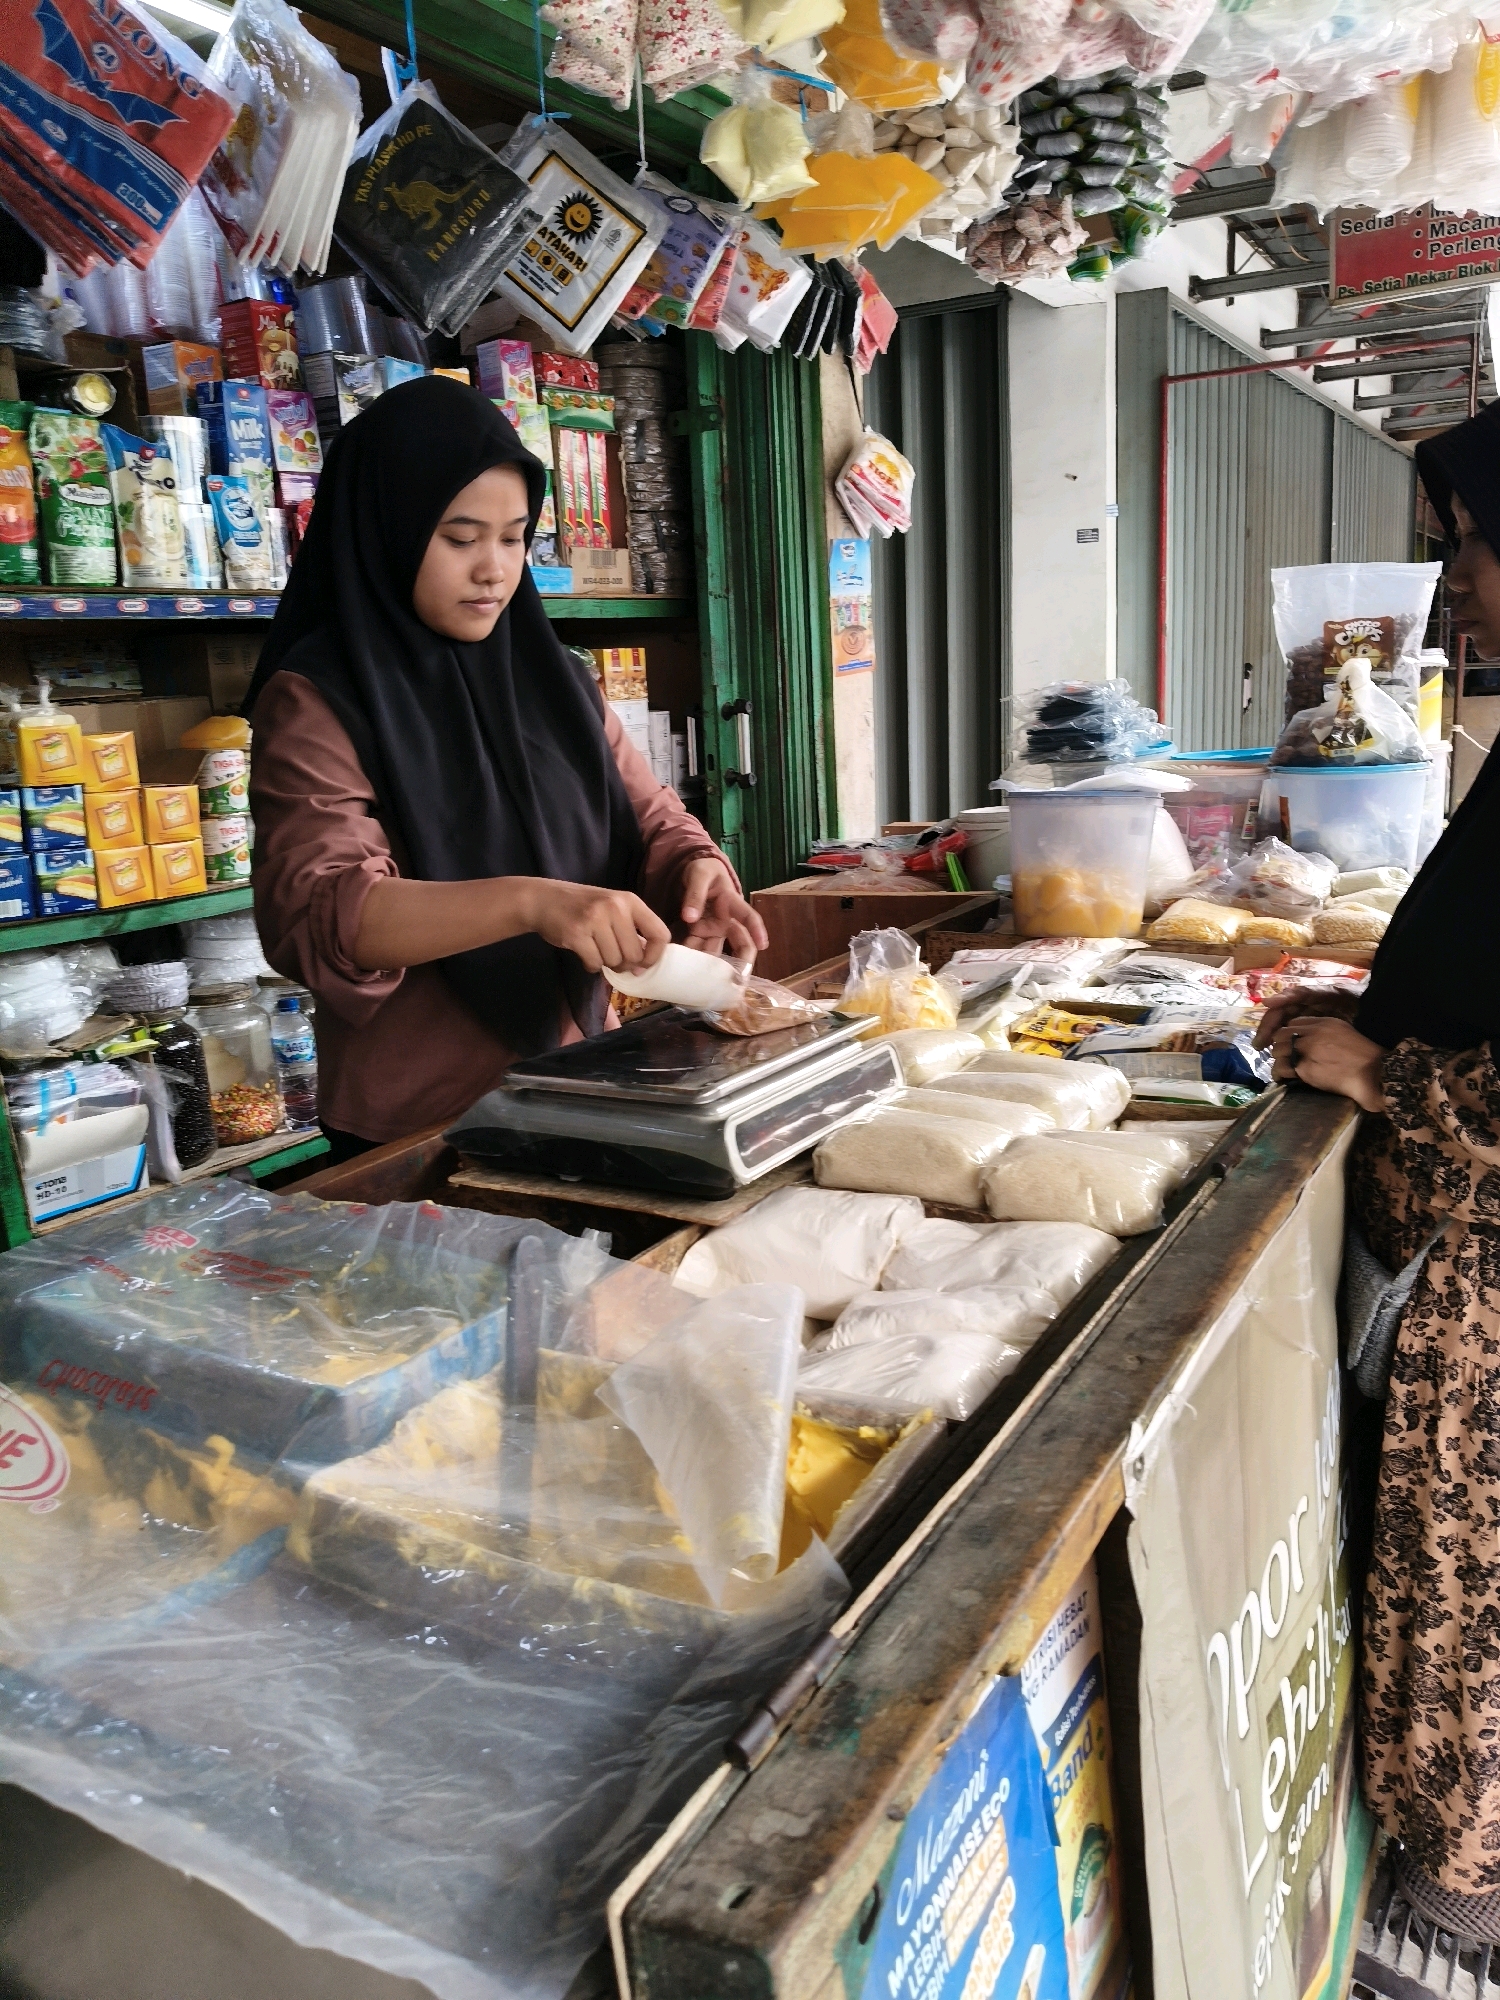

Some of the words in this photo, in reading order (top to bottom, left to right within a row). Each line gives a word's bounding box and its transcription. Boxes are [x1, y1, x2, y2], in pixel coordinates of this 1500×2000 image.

[93, 0, 204, 99] ALONG
[354, 174, 373, 203] TAS
[414, 123, 434, 139] PE
[425, 188, 492, 263] KANGGURU
[537, 226, 589, 273] ATAHARI
[1341, 214, 1395, 236] Sedia
[1364, 278, 1402, 295] Setia
[1406, 269, 1456, 288] Mekar
[1458, 261, 1494, 279] Blok
[230, 417, 266, 441] Milk
[1021, 1623, 1060, 1681] UTRISI
[1050, 1720, 1093, 1814] Band
[1235, 1603, 1331, 1900] Lebih
[887, 1818, 985, 1999] MAYONNAISE
[982, 1777, 1011, 1833] ECO
[908, 1919, 947, 2000] LEBIH
